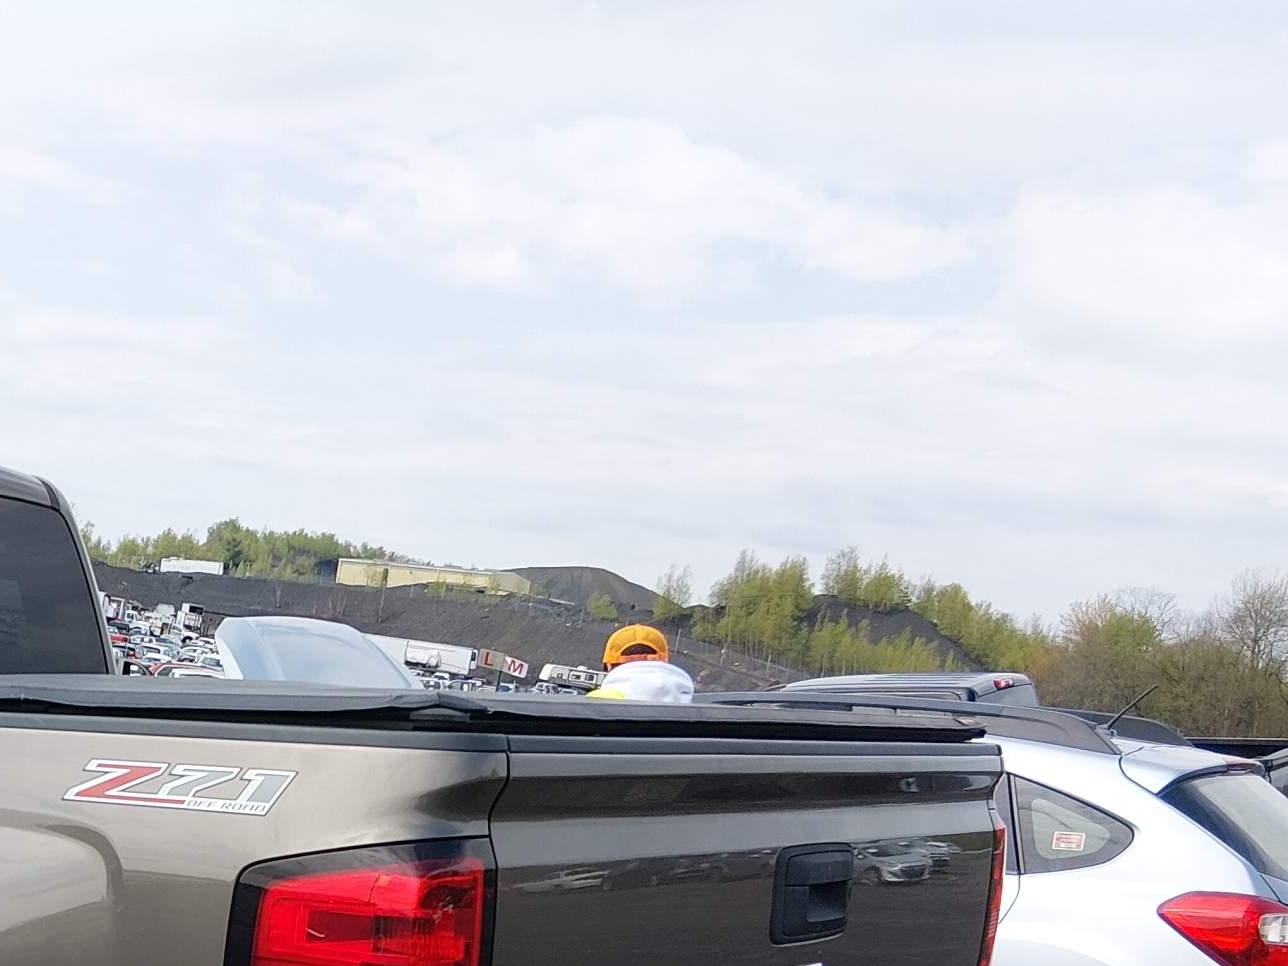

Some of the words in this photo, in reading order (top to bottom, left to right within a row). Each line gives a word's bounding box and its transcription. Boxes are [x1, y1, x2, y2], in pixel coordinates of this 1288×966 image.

[484, 651, 493, 667] L
[508, 660, 524, 675] M
[62, 758, 299, 808] Z71
[187, 799, 215, 808] OFF
[220, 801, 266, 813] ROAD
